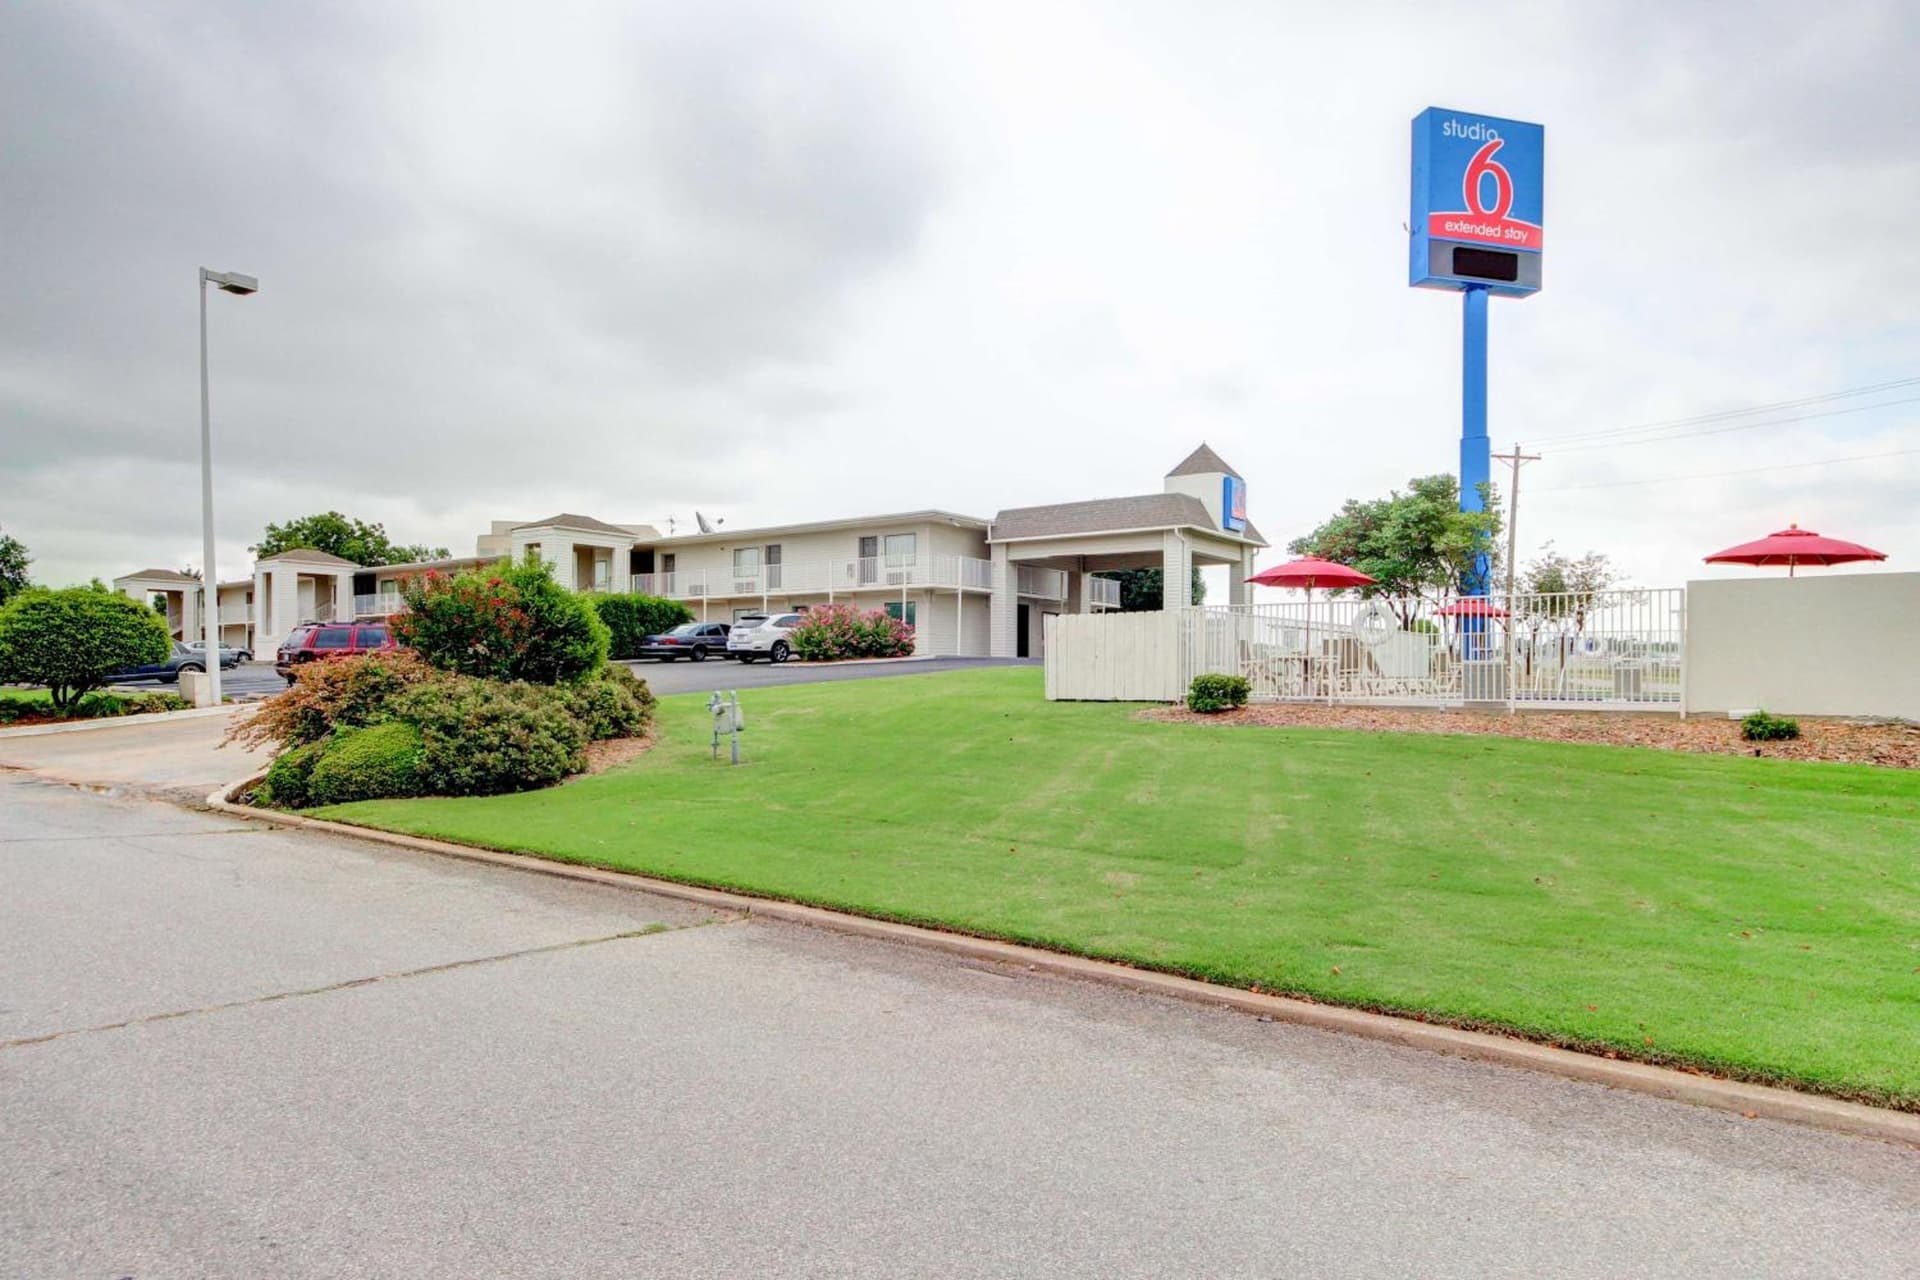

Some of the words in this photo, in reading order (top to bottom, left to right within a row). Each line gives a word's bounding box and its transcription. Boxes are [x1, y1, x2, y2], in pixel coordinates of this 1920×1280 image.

[1443, 119, 1498, 142] studio
[1463, 138, 1513, 220] 6
[1445, 221, 1501, 237] extended
[1504, 228, 1528, 243] stay
